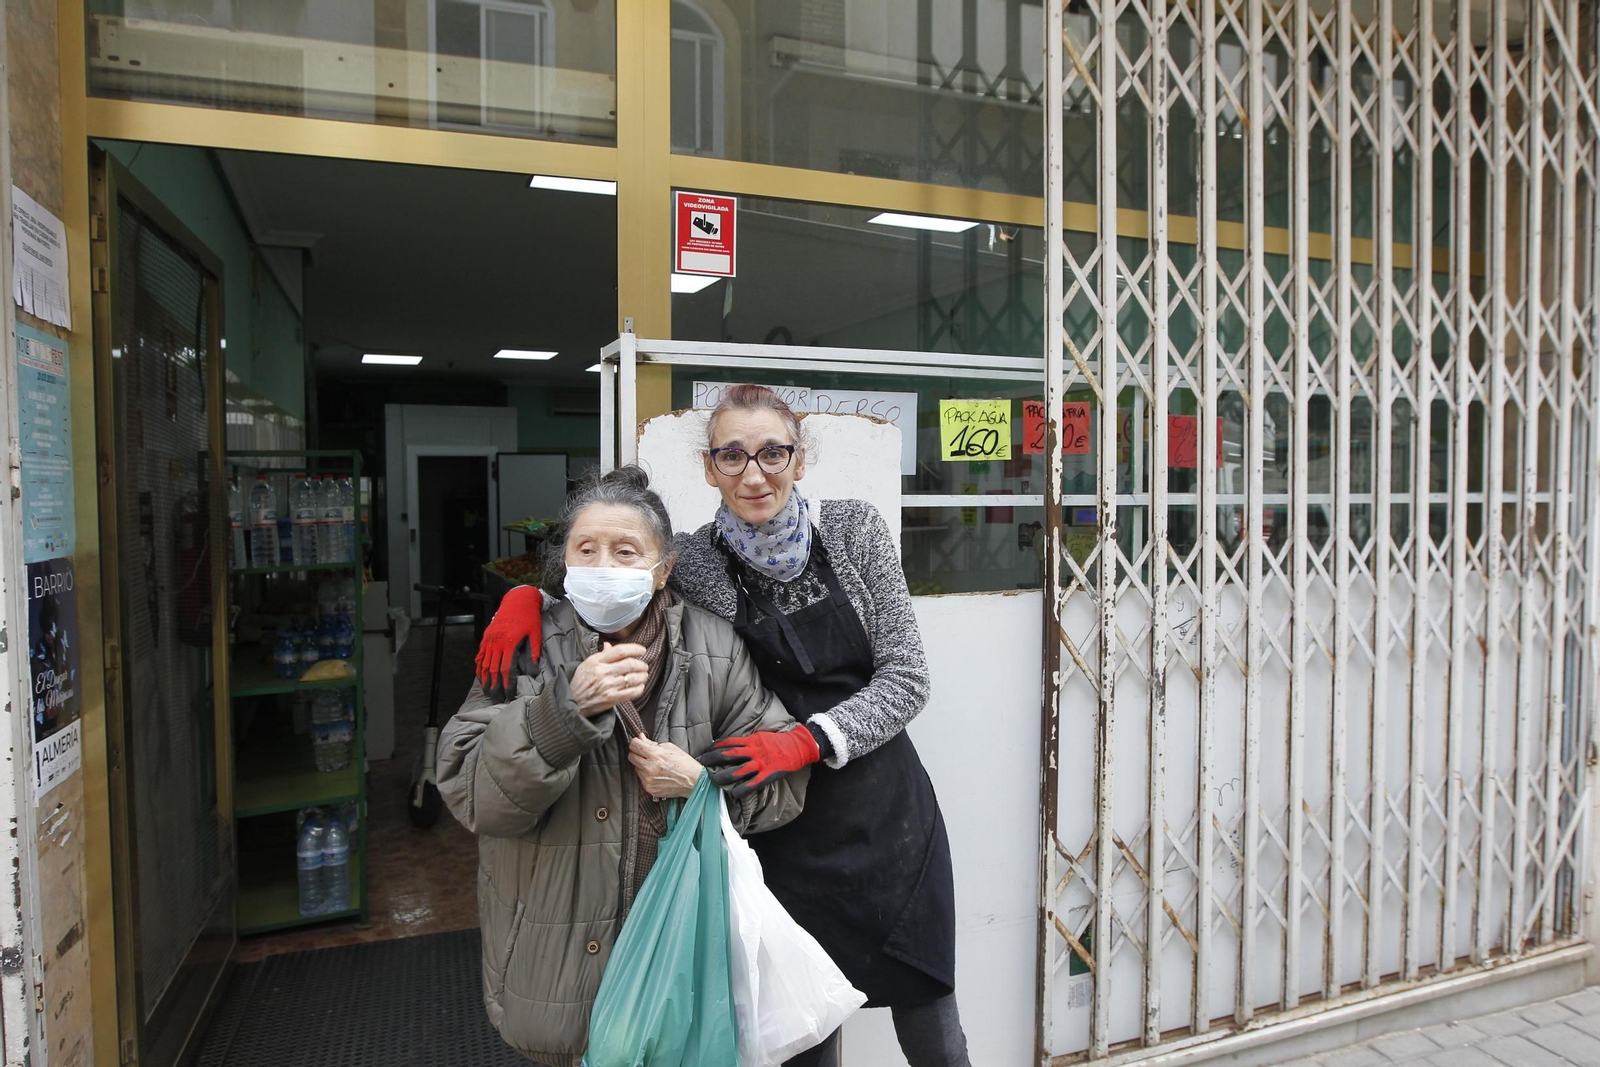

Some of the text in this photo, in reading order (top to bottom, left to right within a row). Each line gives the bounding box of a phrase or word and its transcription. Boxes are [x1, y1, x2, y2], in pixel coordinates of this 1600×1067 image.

[683, 202, 730, 212] VIDEOVIGILADA
[697, 197, 716, 205] ZONA
[695, 382, 731, 408] PO
[944, 406, 1008, 425] PACK AGUA
